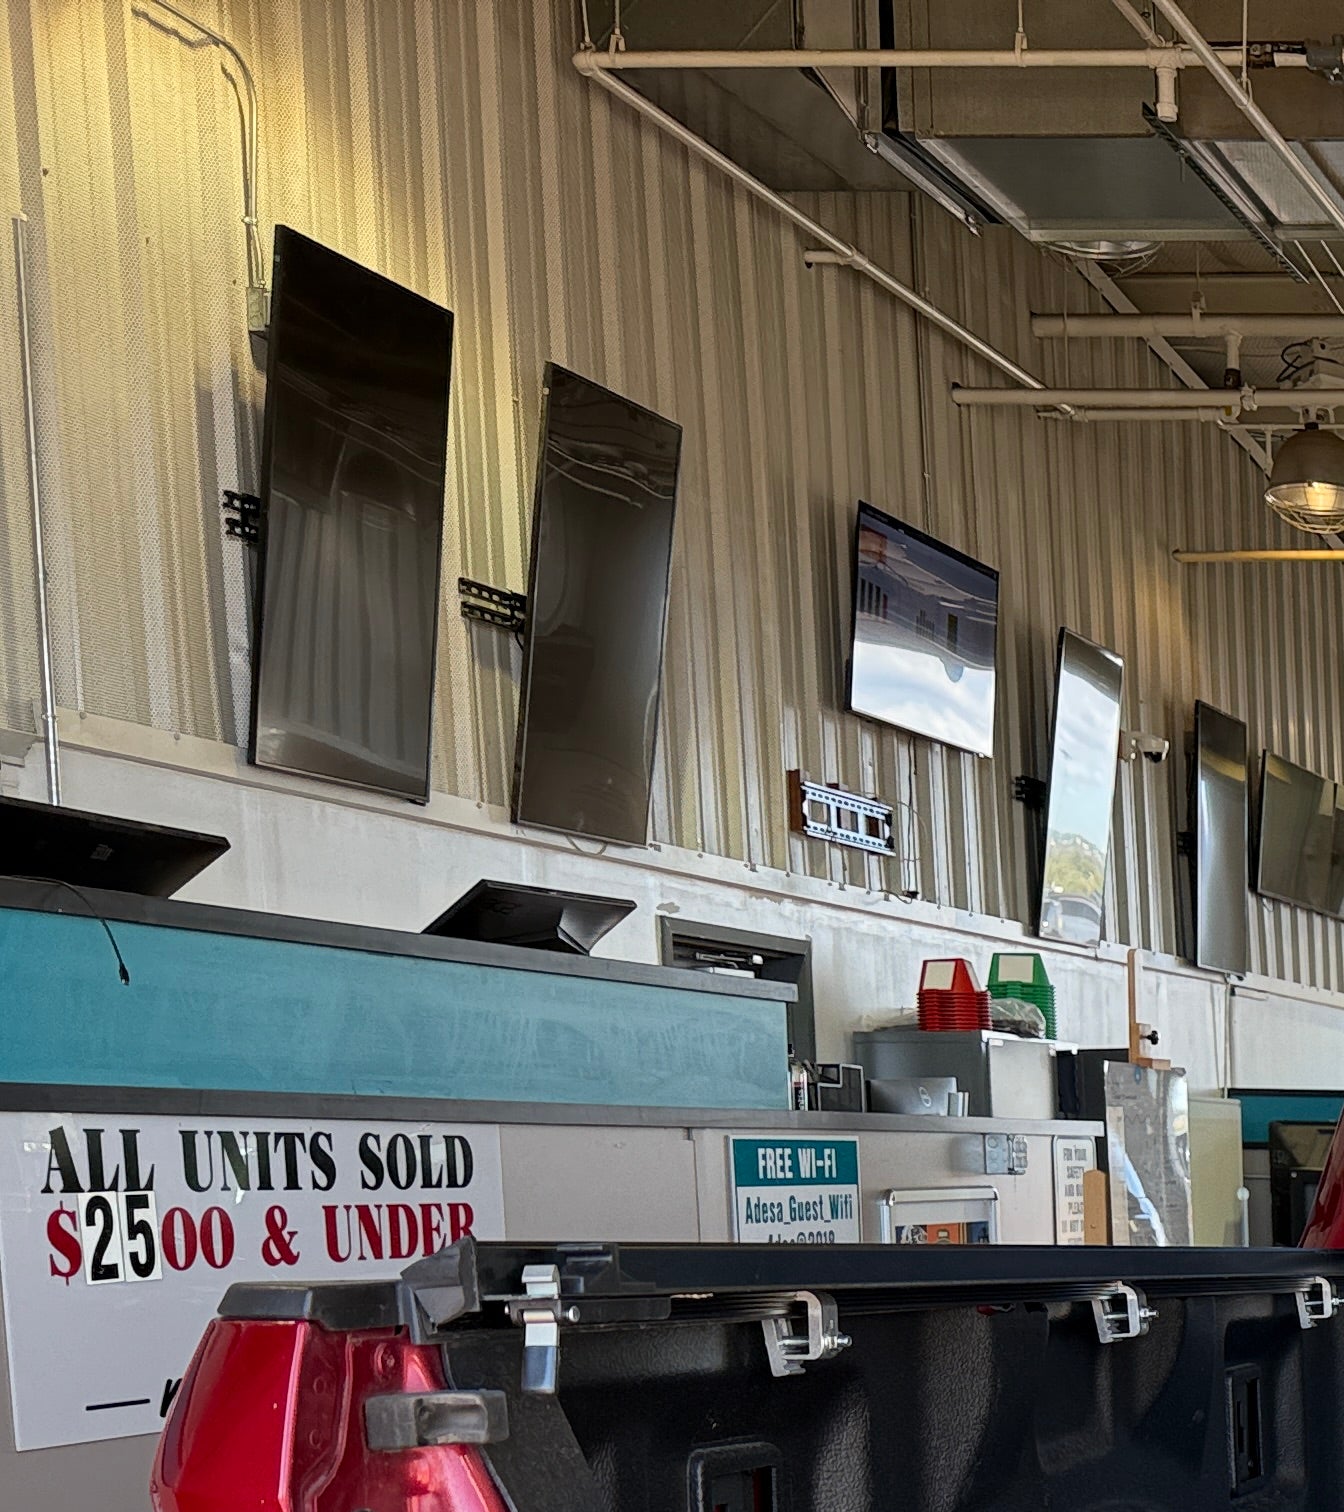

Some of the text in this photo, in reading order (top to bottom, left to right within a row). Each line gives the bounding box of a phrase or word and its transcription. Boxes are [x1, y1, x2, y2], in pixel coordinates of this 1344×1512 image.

[41, 1126, 474, 1194] ALL UNITS SOLD
[757, 1148, 837, 1179] FREE WI-FI
[46, 1194, 235, 1285] $2500
[261, 1205, 300, 1267] &
